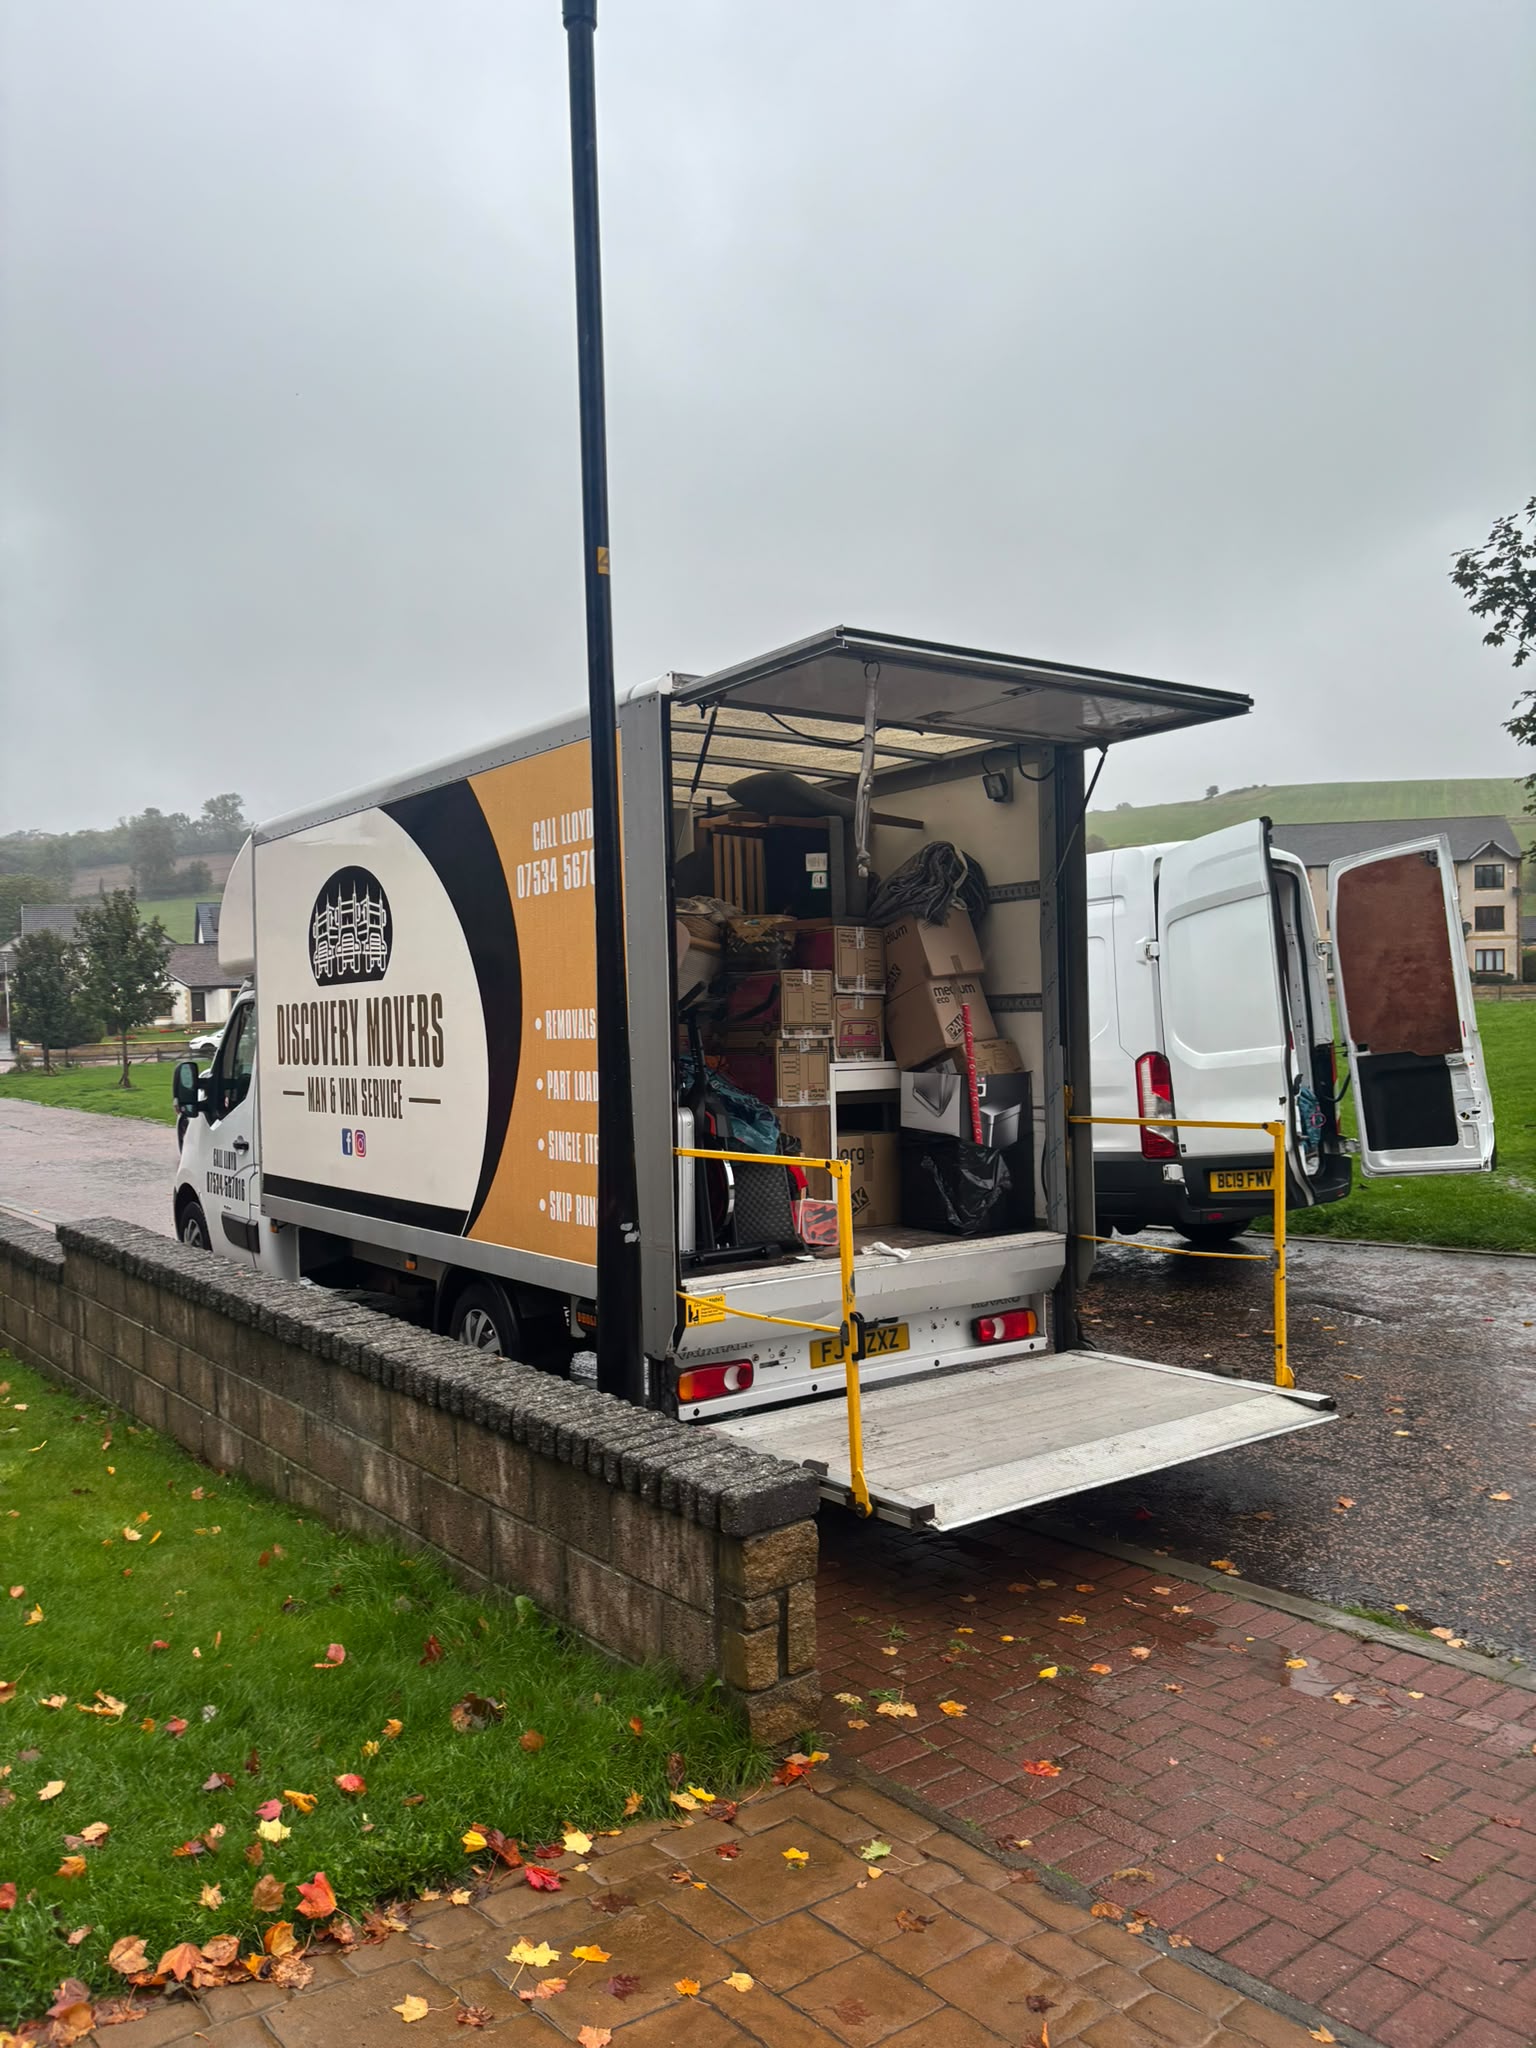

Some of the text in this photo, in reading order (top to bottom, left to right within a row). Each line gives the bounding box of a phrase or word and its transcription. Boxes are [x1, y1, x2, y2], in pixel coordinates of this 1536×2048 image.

[532, 807, 595, 851] CALL LLOYD
[516, 857, 558, 899] 07534
[277, 993, 444, 1068] DISCOVERY MOVERS
[545, 1008, 596, 1039] REMOVALS
[308, 1076, 403, 1119] MAN & VAN SERVICE
[547, 1070, 571, 1100] PART
[548, 1130, 582, 1163] SINGLE
[549, 1190, 598, 1228] SKIP RUN
[866, 1327, 900, 1354] ZXZ
